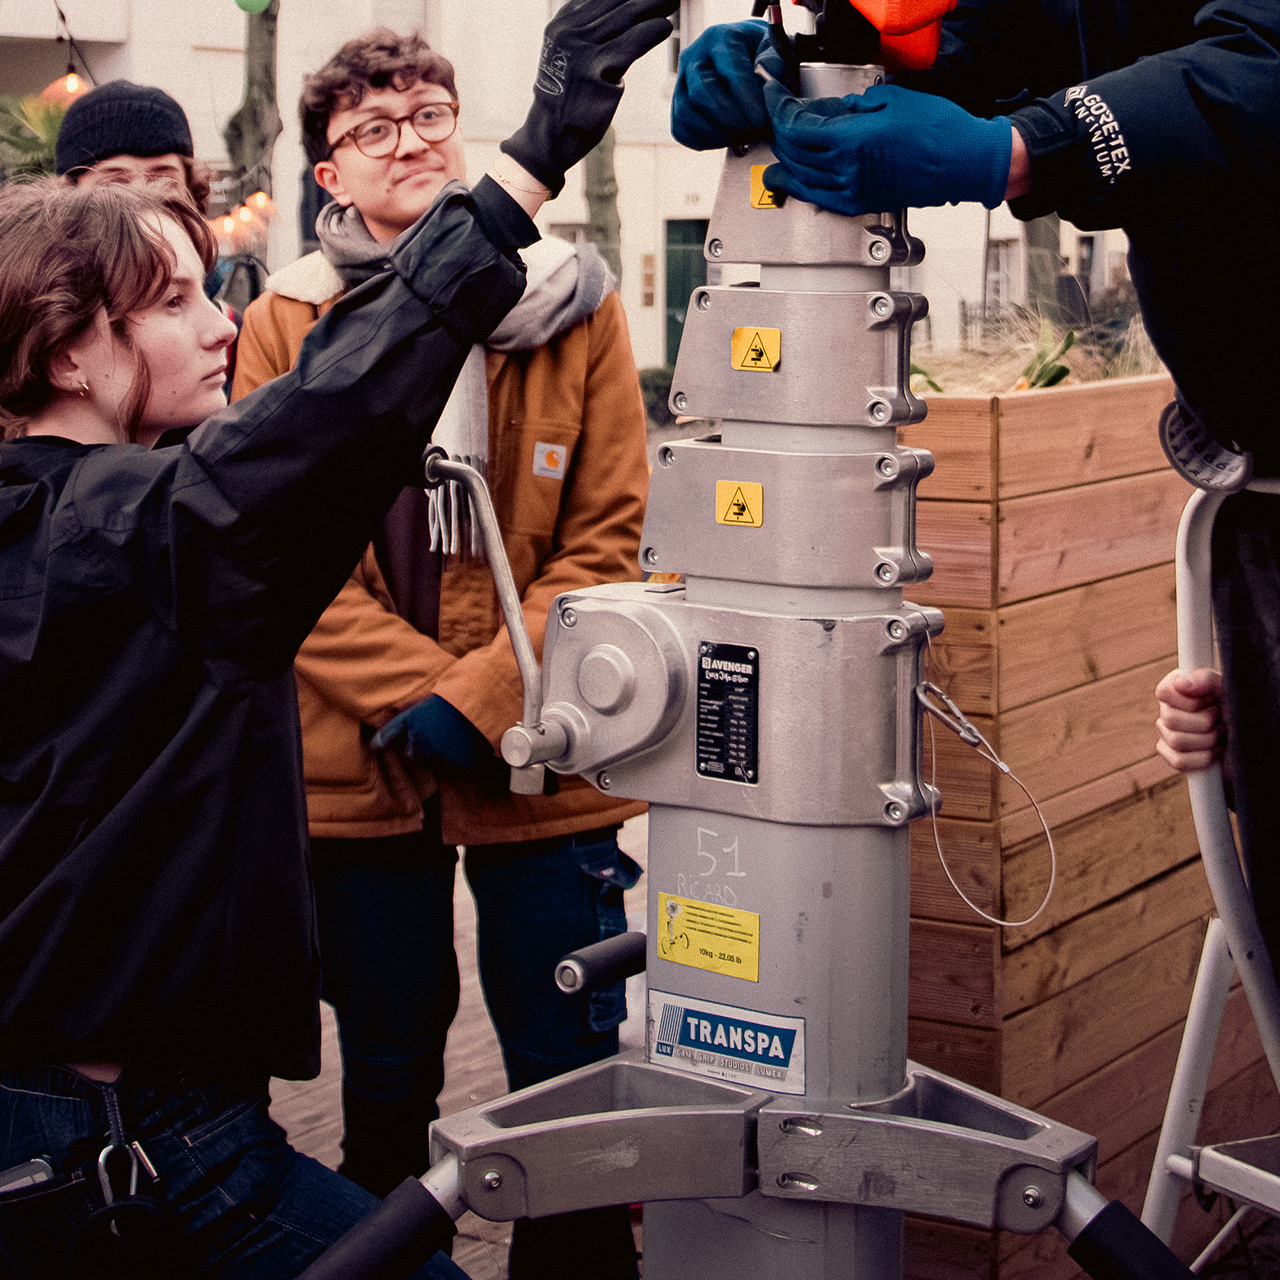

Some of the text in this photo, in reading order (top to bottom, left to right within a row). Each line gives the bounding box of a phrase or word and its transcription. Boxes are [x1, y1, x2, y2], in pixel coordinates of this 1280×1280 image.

[711, 659, 753, 674] AVENGER
[697, 827, 746, 877] 51
[686, 1016, 785, 1060] TRANSPA
[658, 1044, 671, 1054] LUX
[720, 1058, 749, 1072] STUDIOS
